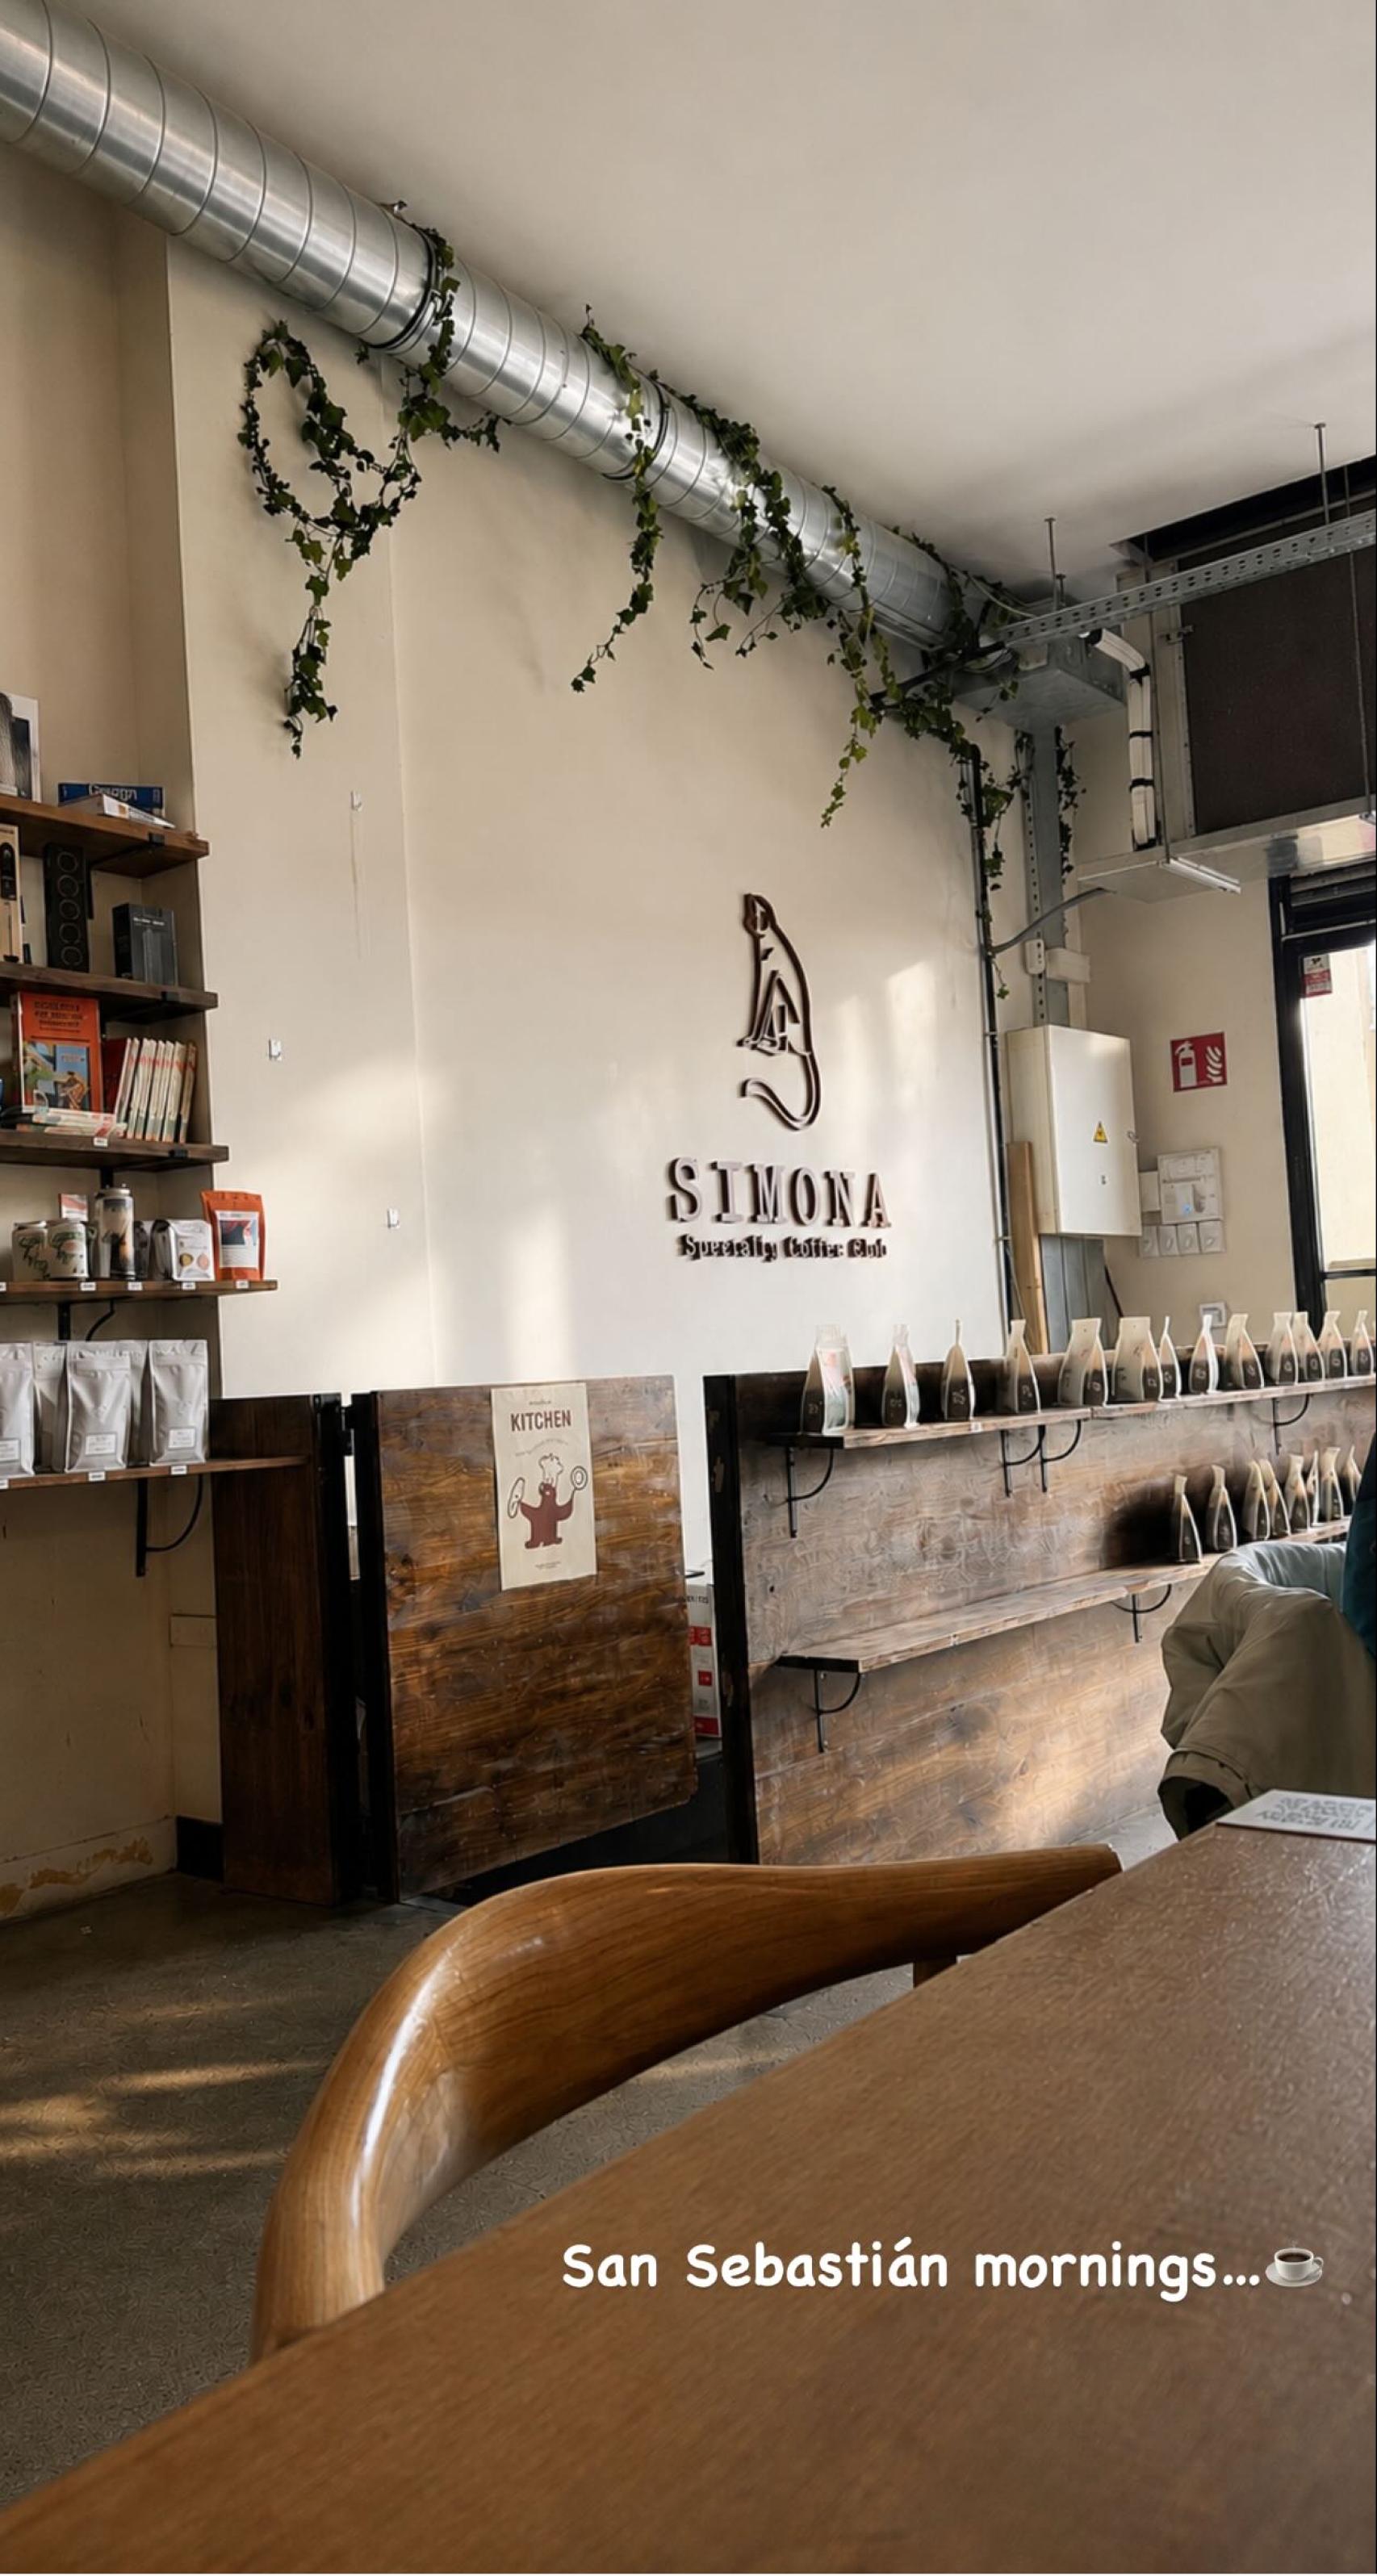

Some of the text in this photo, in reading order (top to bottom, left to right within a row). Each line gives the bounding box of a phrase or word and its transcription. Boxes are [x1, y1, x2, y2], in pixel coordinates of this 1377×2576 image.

[667, 1156, 892, 1227] SIMONA
[847, 1238, 887, 1258] Club
[510, 1409, 571, 1432] KITCHEN
